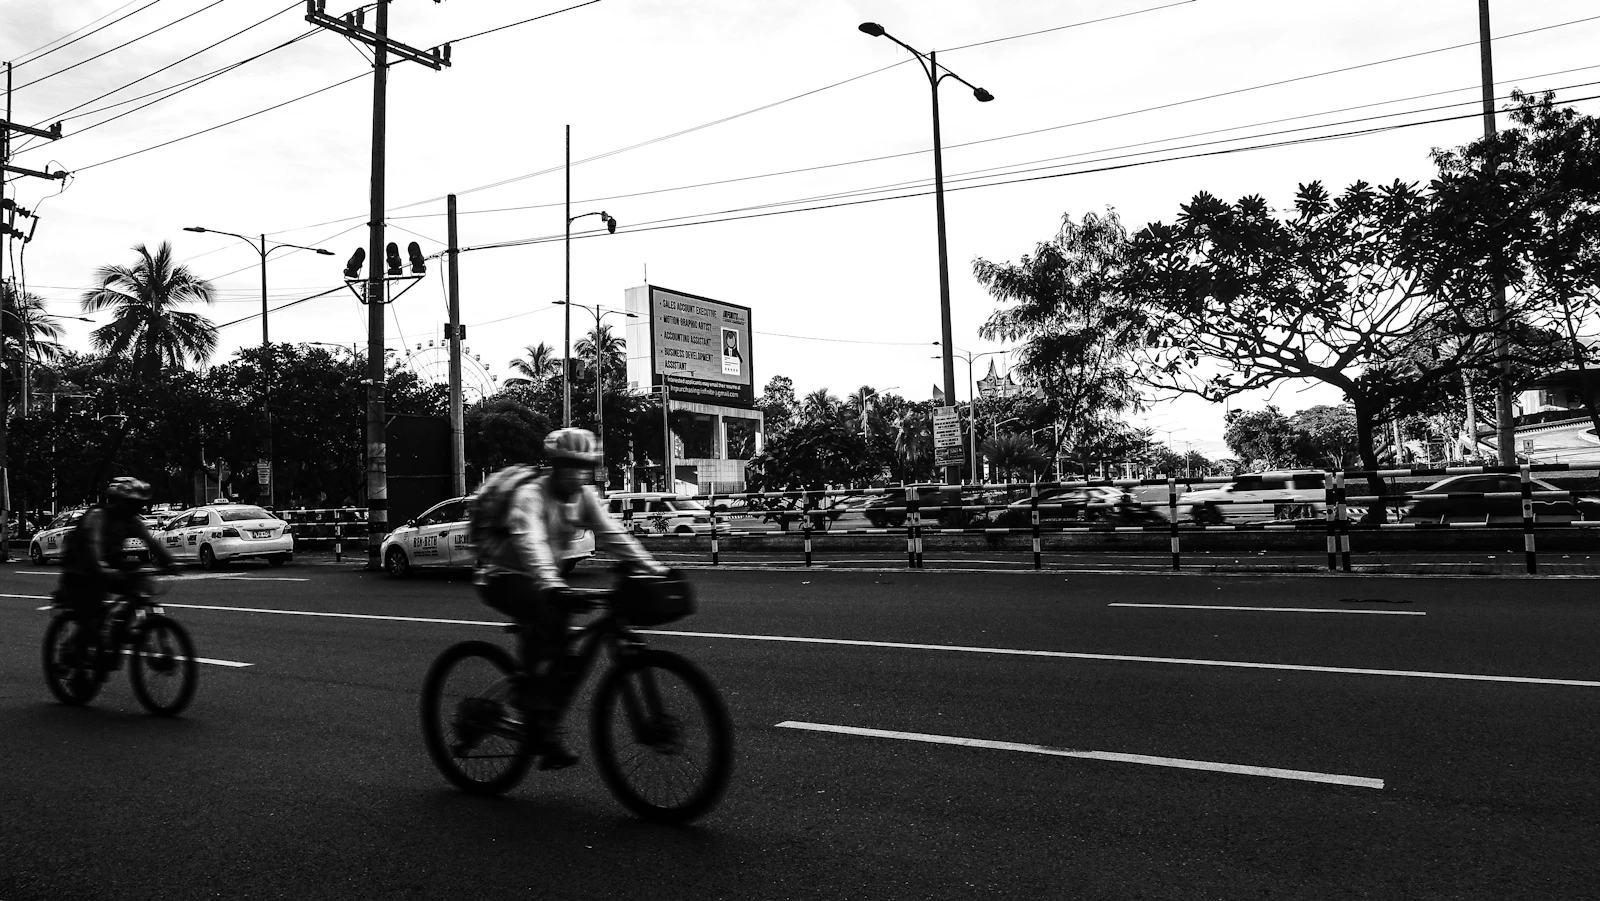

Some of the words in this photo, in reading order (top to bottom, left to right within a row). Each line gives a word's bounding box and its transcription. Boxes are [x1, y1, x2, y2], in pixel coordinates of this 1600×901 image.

[662, 299, 676, 310] SALES
[676, 302, 695, 314] ACCOUNT
[696, 306, 717, 318] EXECUTIVE
[663, 315, 680, 325] MOTION
[680, 318, 698, 329] GRAPHIC
[698, 321, 712, 332] ARTIST
[664, 331, 690, 343] ACCOUNTING
[690, 335, 712, 347] ASSISTANT
[664, 348, 684, 358] BUSINESS
[685, 350, 714, 362] DEVELOPMENT
[664, 360, 687, 371] ASSISTANT
